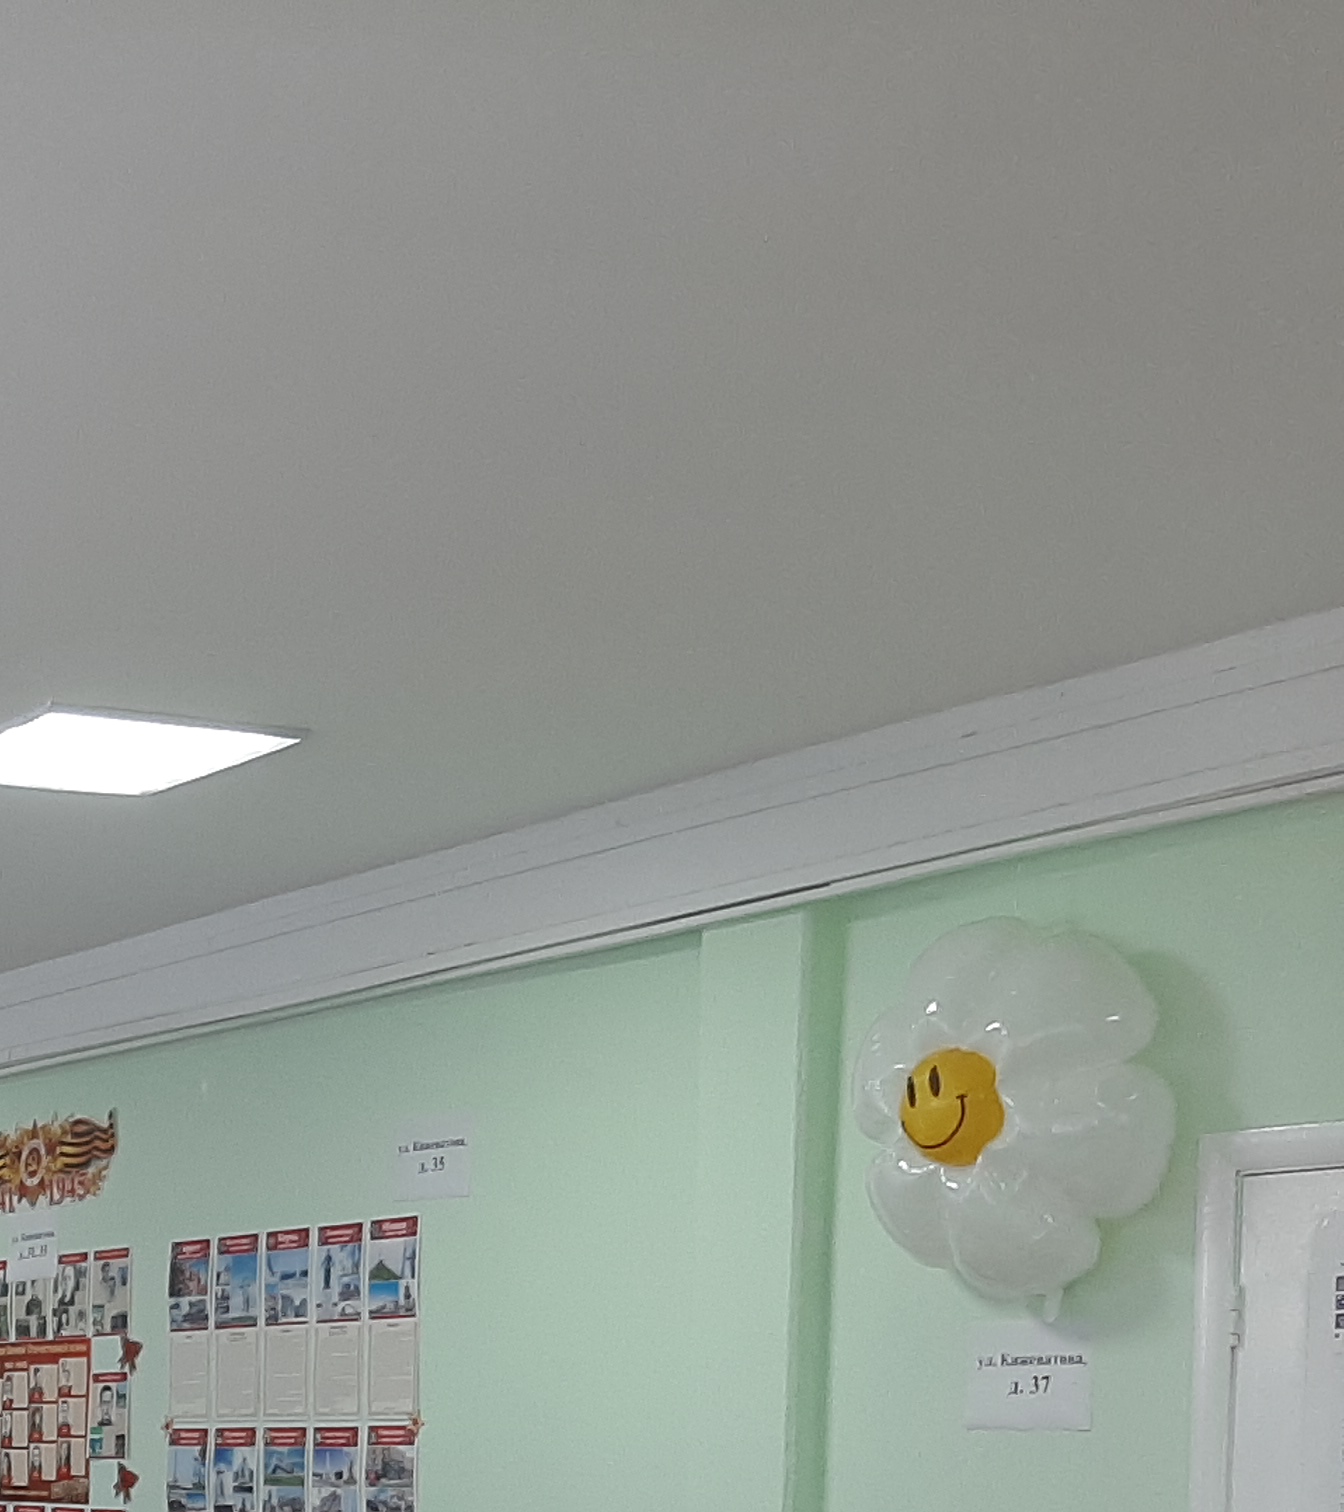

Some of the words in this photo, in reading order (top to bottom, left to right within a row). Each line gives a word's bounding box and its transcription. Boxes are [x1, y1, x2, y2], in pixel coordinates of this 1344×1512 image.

[47, 1170, 90, 1207] 1945
[1007, 1381, 1025, 1396] д.
[1028, 1374, 1052, 1395] 37
